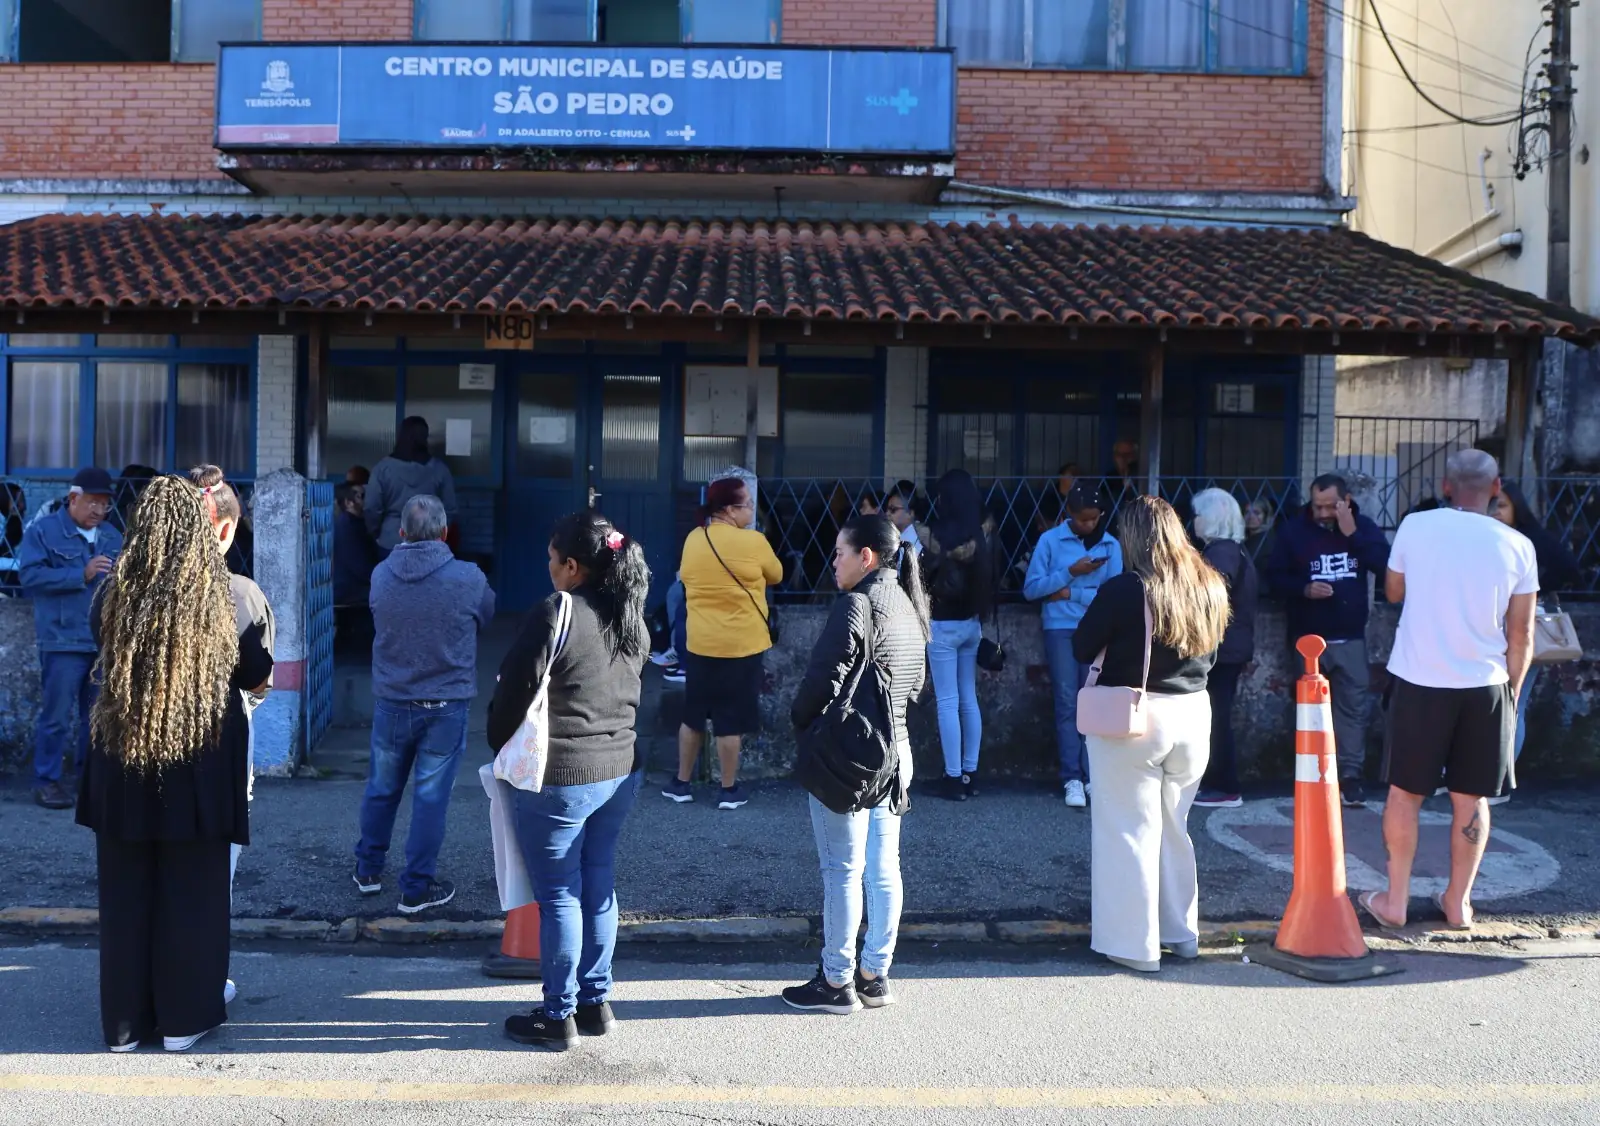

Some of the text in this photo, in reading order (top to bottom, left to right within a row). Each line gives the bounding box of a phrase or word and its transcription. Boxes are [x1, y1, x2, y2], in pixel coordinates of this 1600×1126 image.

[385, 56, 782, 80] CENTRO MUNICIPAL DE SAÚDE
[244, 96, 312, 108] TERESÓPOLIS
[493, 86, 674, 116] SÃO PEDRO
[497, 128, 513, 137] DR
[514, 128, 572, 138] ADALBERTO
[575, 128, 602, 138] OTTO
